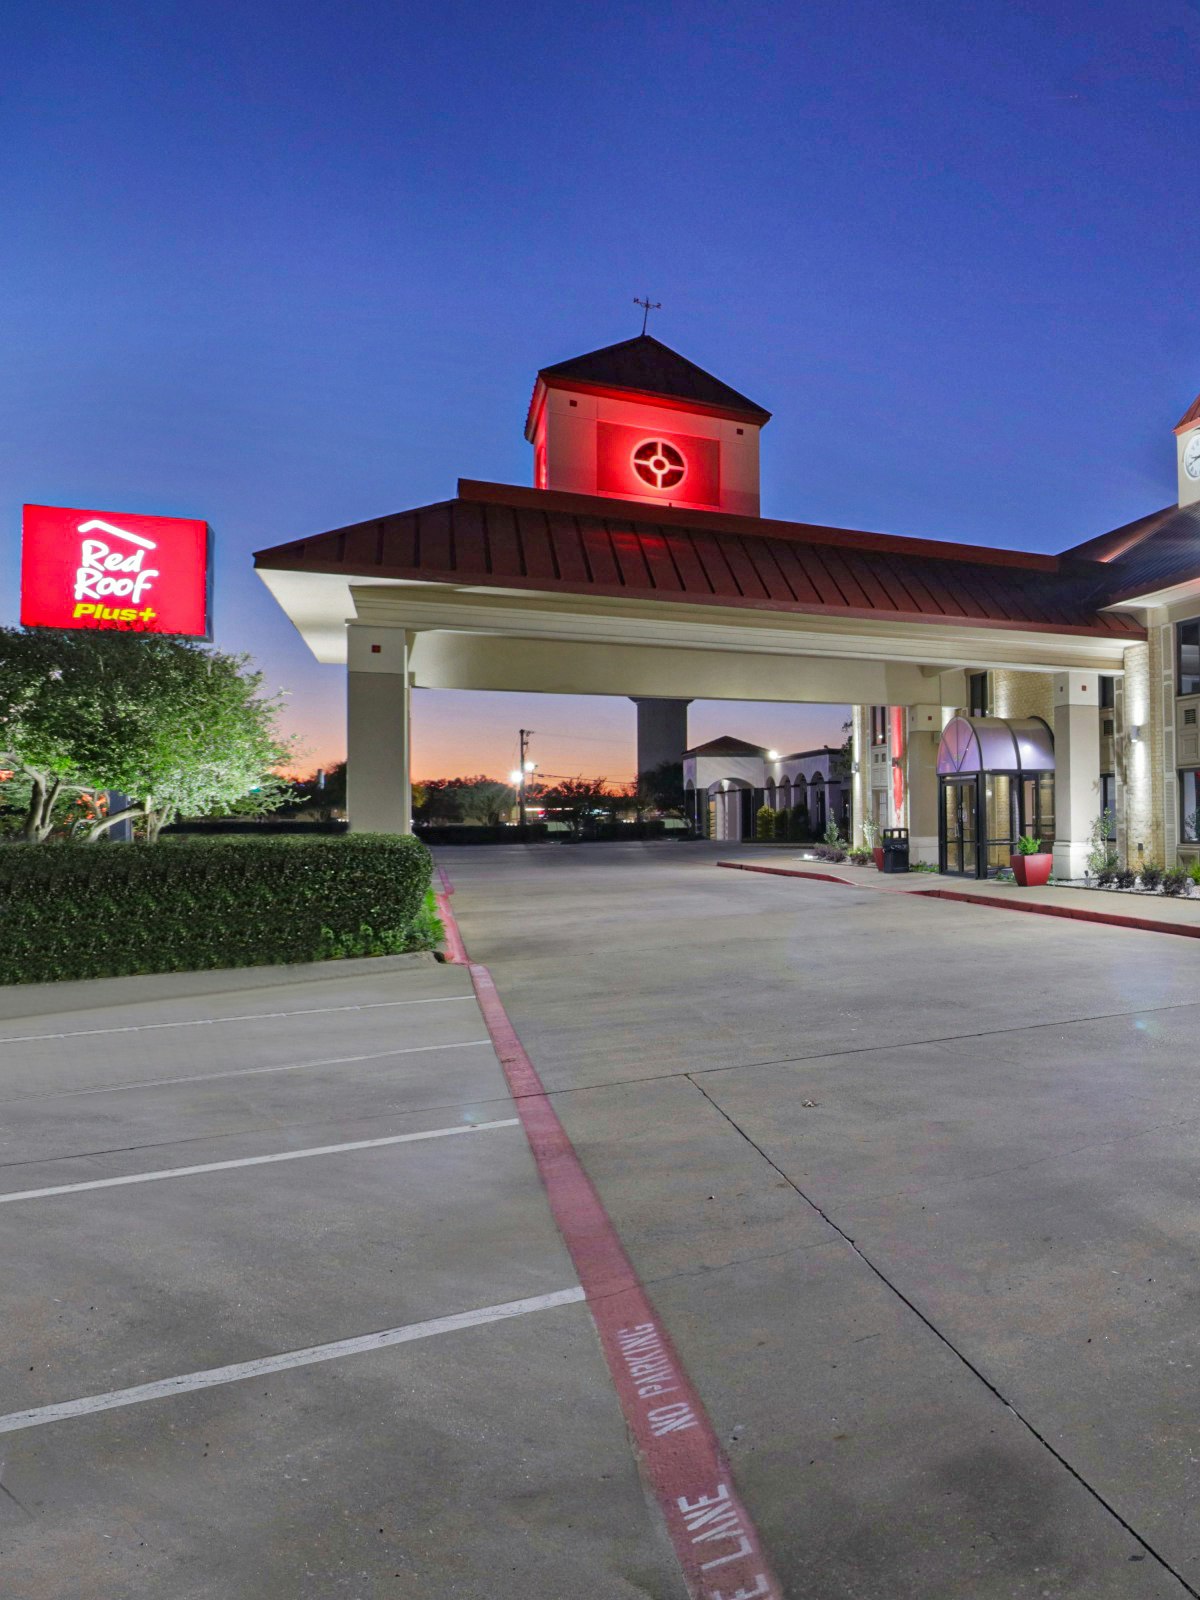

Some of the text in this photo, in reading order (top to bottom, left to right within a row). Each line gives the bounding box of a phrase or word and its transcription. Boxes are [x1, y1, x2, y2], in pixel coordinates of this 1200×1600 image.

[81, 539, 145, 572] Red
[74, 567, 159, 604] Roof
[72, 603, 157, 622] Plus+
[617, 1322, 699, 1437] NO PARKING
[677, 1484, 753, 1571] LANE
